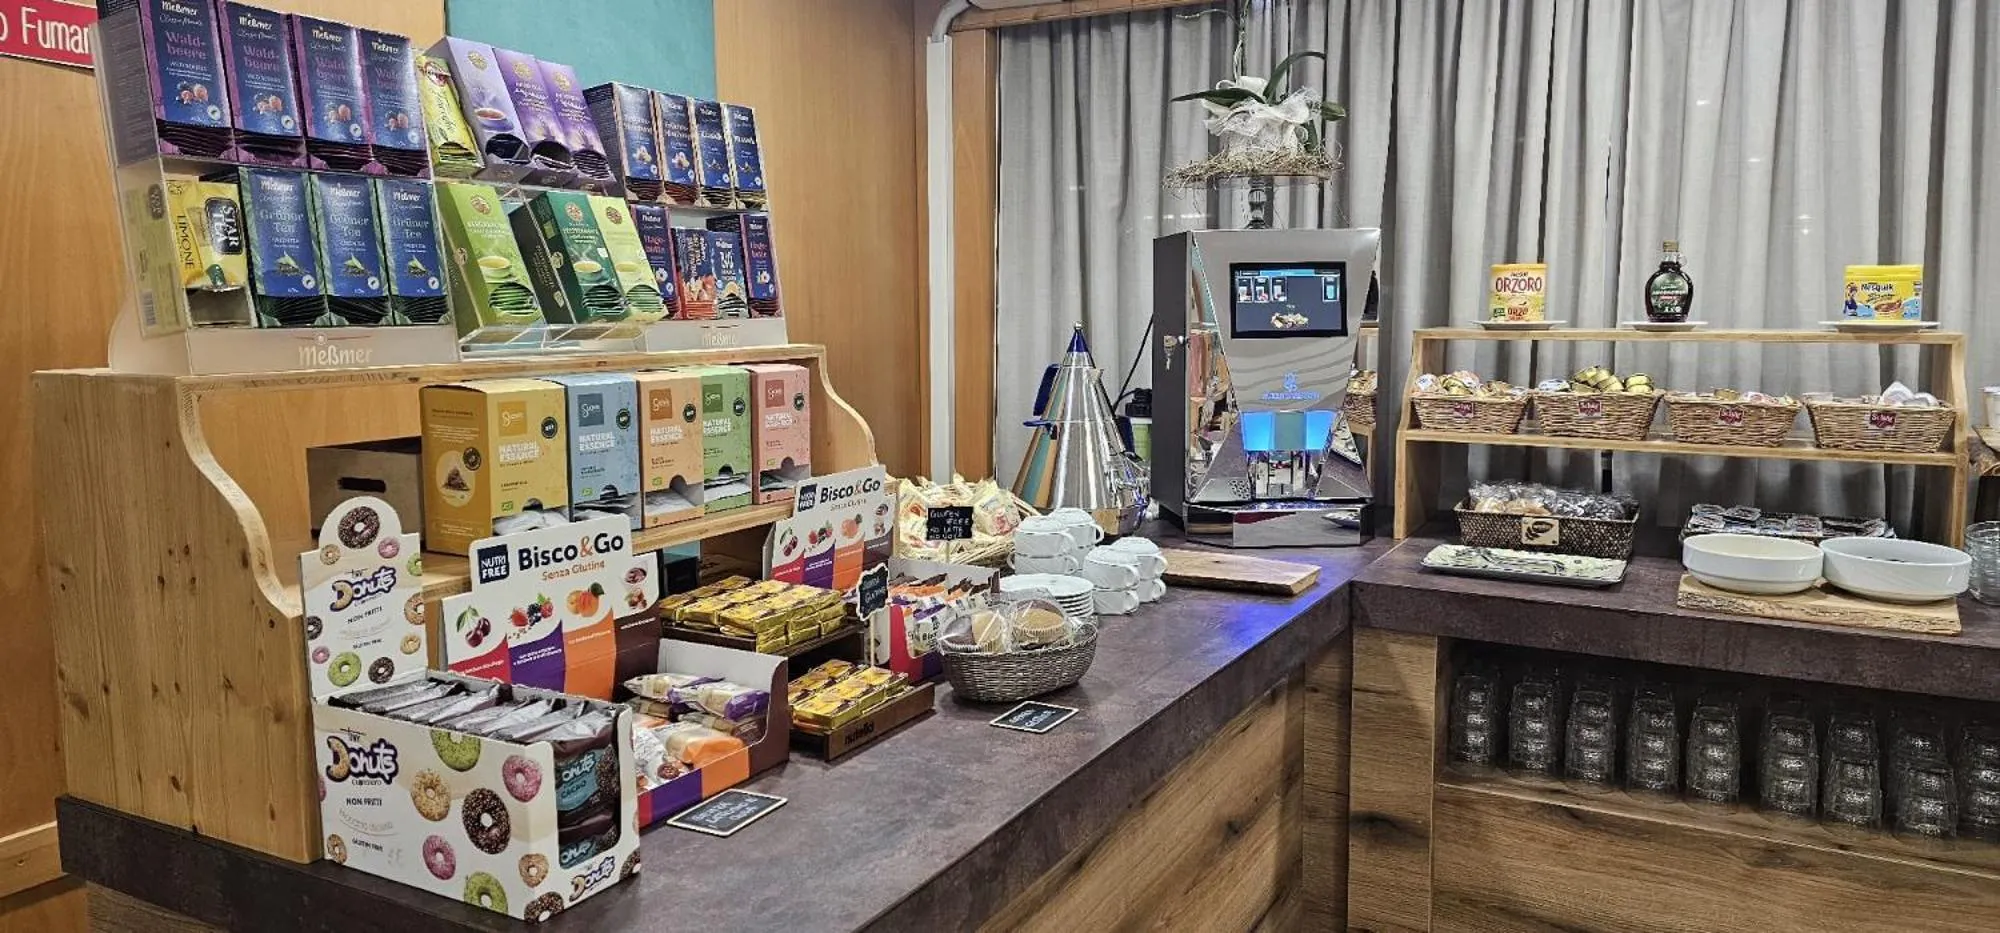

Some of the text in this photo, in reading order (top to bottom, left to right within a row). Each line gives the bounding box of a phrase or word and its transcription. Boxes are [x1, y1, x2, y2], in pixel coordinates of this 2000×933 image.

[259, 206, 304, 221] Grüner
[223, 205, 240, 248] STAR
[177, 215, 195, 269] LIMONE
[1495, 277, 1542, 293] ORZORO
[299, 345, 373, 366] Meßmer
[703, 417, 731, 427] NATURAL
[579, 432, 615, 443] NATURAL
[650, 425, 683, 436] NATURAL
[820, 478, 881, 504] Bisco&Go
[518, 532, 624, 572] Bisco&Go
[481, 555, 506, 569] NUTRI
[482, 565, 507, 579] FREE
[542, 560, 605, 581] Senza Glutine
[346, 797, 362, 806] NON
